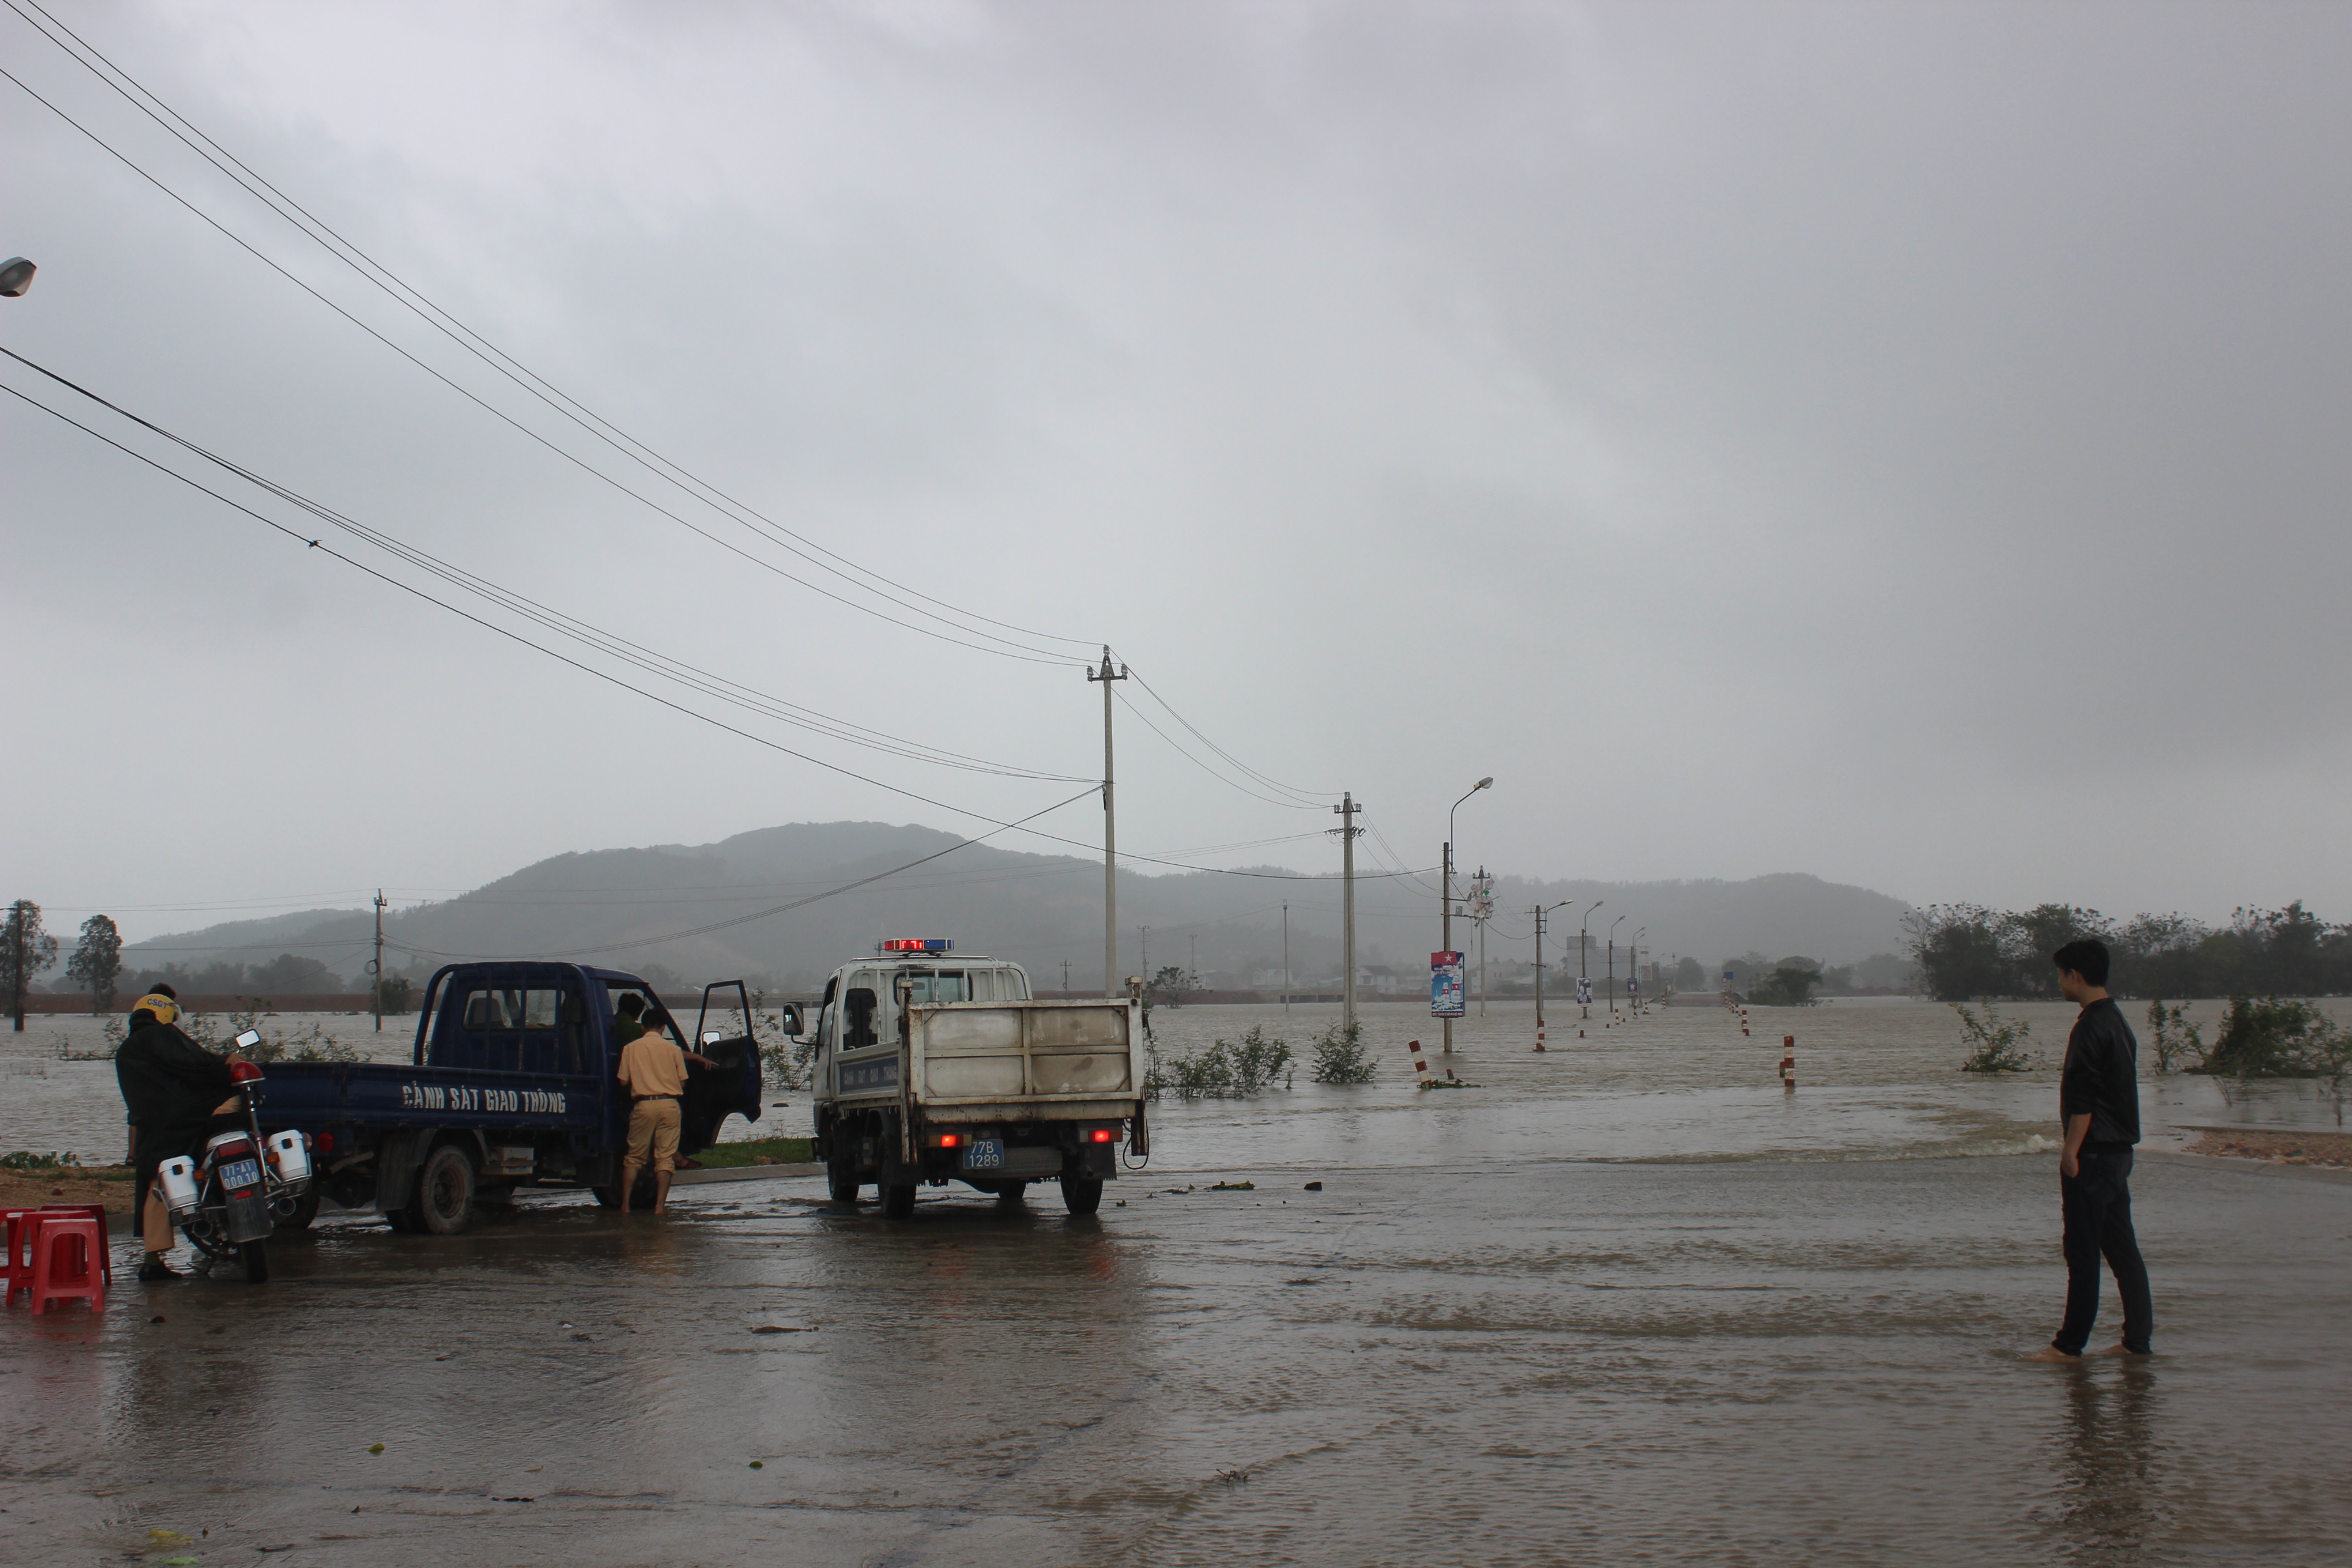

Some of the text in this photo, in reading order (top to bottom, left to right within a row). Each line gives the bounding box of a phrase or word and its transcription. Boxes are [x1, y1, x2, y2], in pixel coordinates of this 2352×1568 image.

[147, 998, 168, 1009] CSGT
[450, 1085, 478, 1111] SÁT
[521, 1088, 566, 1113] THÔNG
[972, 1141, 994, 1154] 77B
[970, 1154, 999, 1167] 1289
[225, 1162, 251, 1177] 77-A1
[224, 1171, 258, 1188] 000.10
